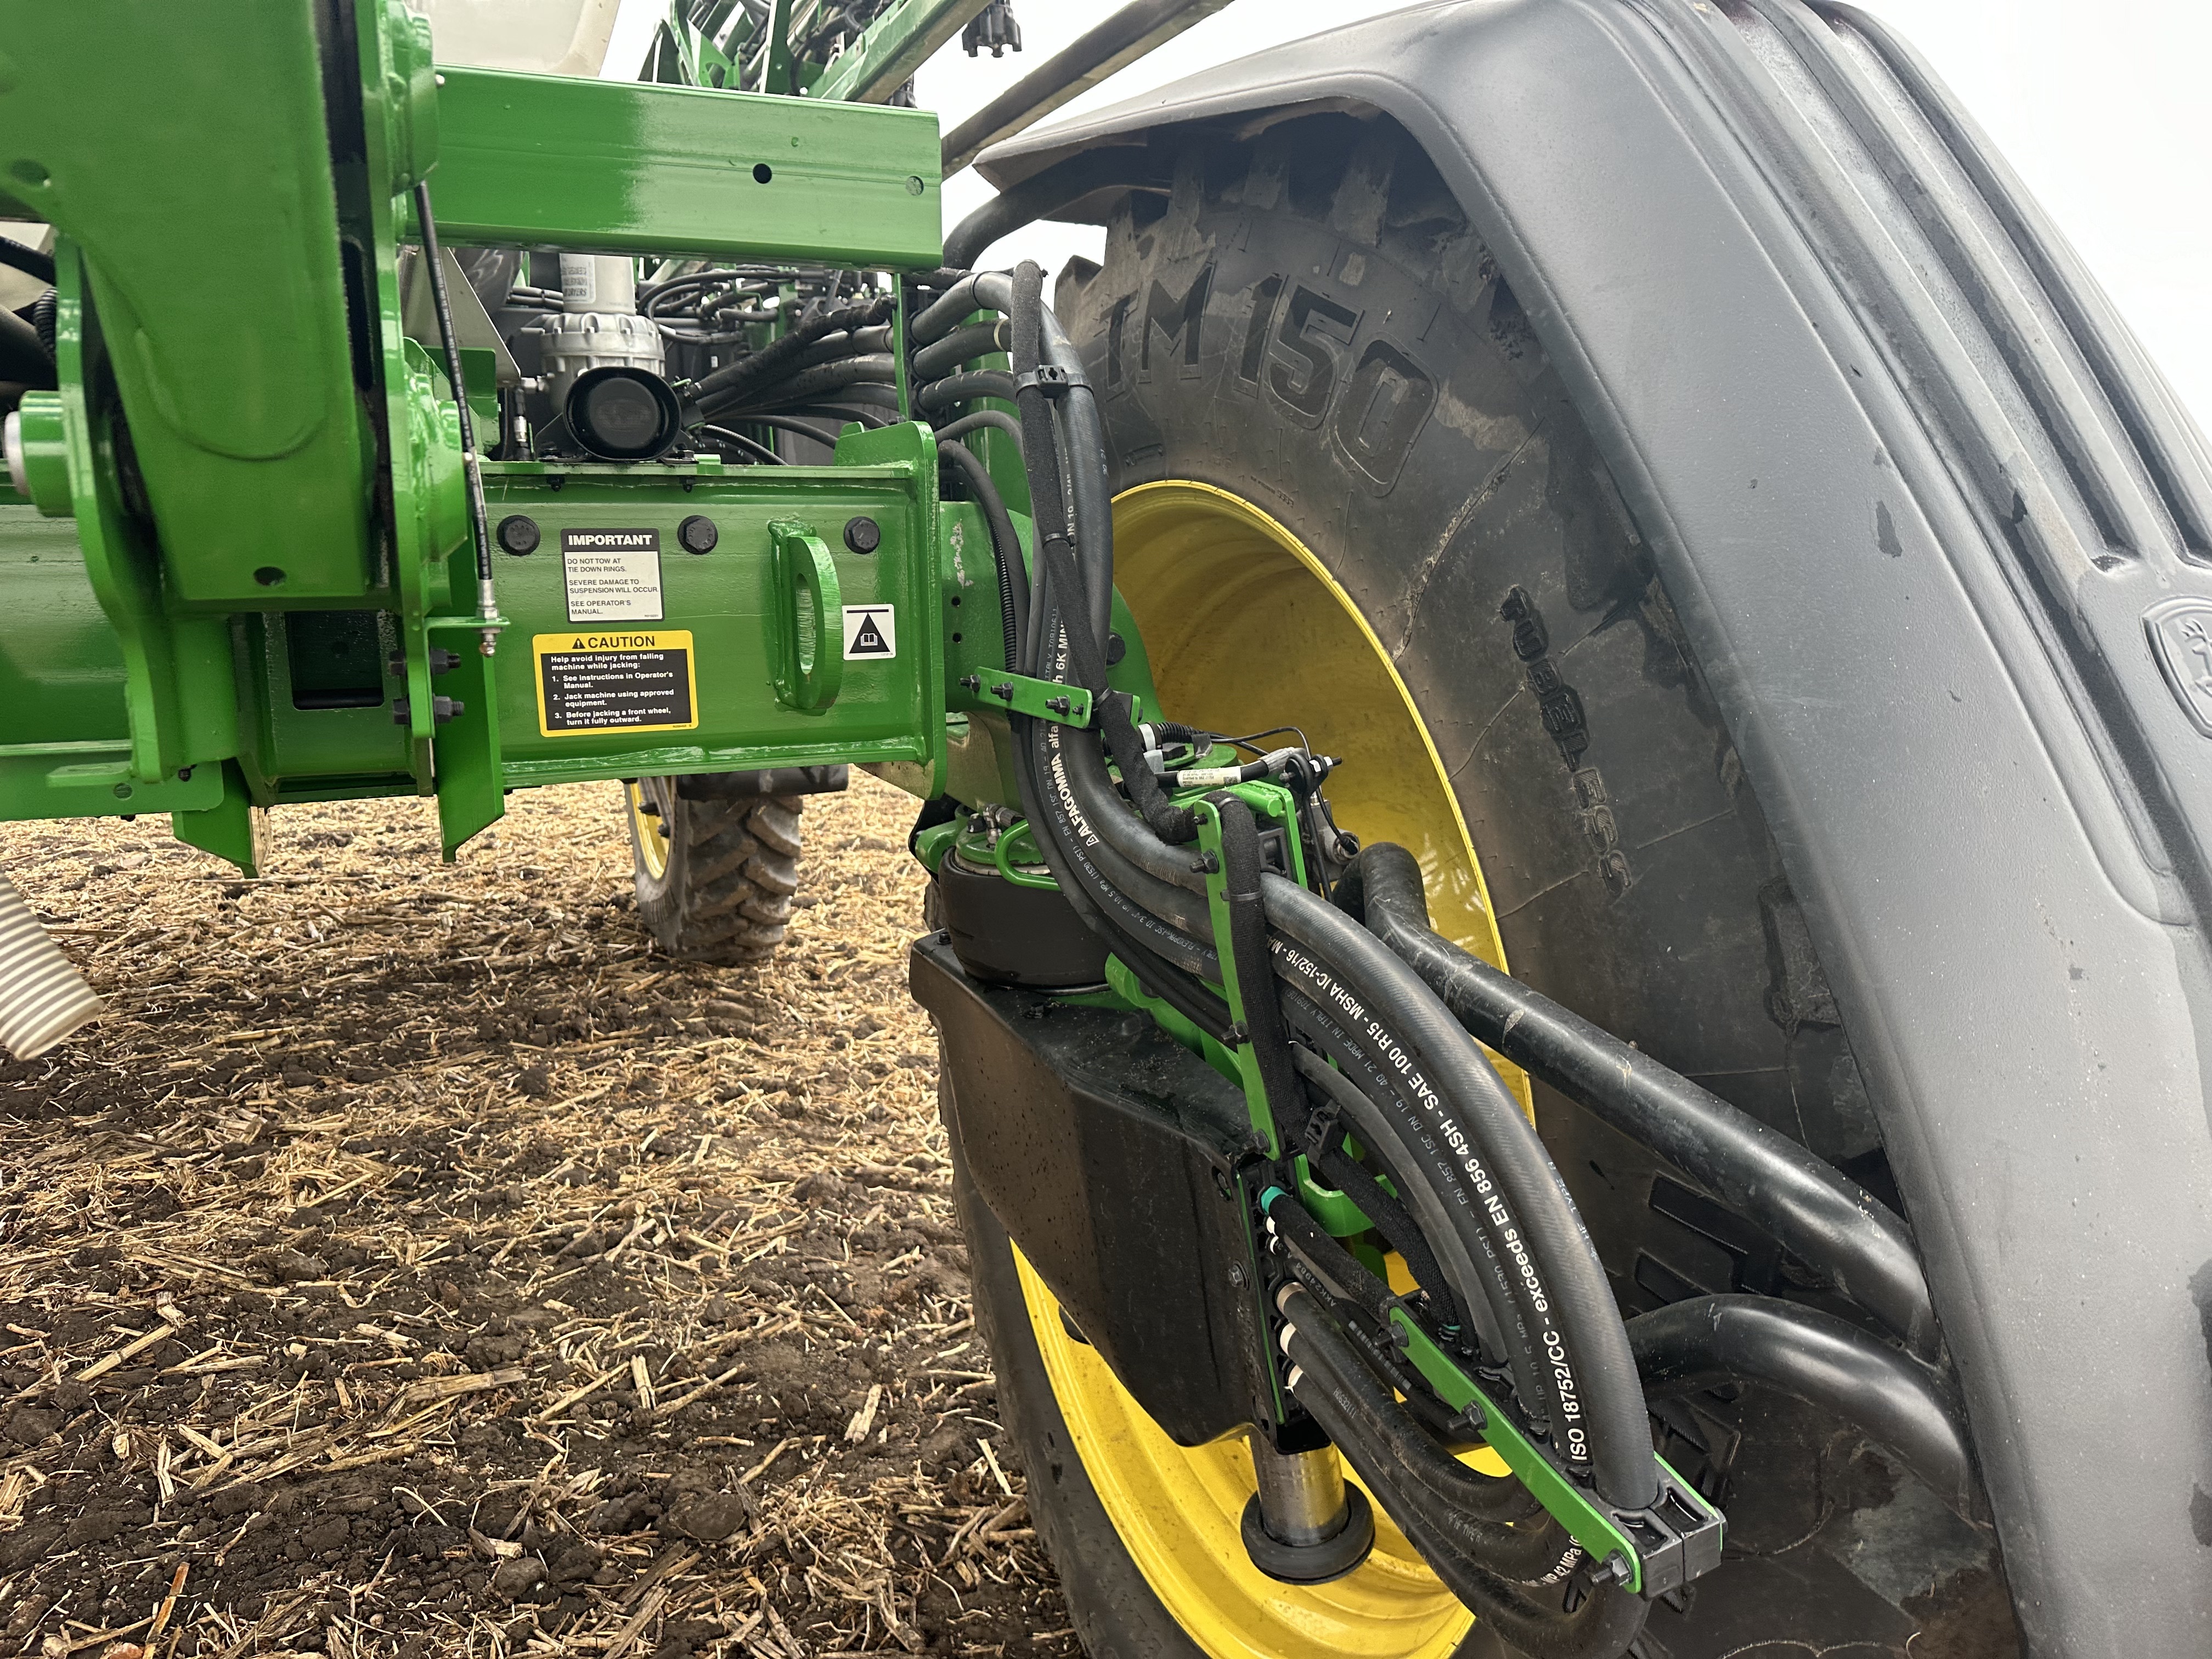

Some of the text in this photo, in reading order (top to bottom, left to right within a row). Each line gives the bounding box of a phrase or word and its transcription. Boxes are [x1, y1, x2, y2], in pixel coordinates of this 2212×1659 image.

[1095, 261, 1437, 495] TM 150
[568, 535, 652, 545] IMPORTANT
[588, 636, 655, 648] CAUTION
[551, 656, 569, 664] Help
[595, 654, 617, 662] injury
[1056, 652, 1066, 670] 6K
[640, 689, 674, 697] approved
[1501, 585, 1632, 896] TUBELESS
[1051, 752, 1093, 837] ALFAGOMMA
[1055, 809, 1066, 823] 857
[1061, 824, 1072, 836] EN
[1072, 843, 1087, 862] PSI)
[1286, 950, 1332, 990] IC-152/16
[1330, 982, 1365, 1020] MSHA
[1310, 1006, 1334, 1030] ITALY
[1331, 1025, 1345, 1039] IN
[1366, 1022, 1393, 1051] R15
[1342, 1037, 1365, 1060] MADE
[1389, 1047, 1412, 1075] 100
[1363, 1059, 1377, 1073] 21
[1408, 1073, 1439, 1110] SAE
[1395, 1097, 1409, 1113] 19
[1407, 1114, 1423, 1132] DN
[1419, 1132, 1441, 1155] 1SC
[1440, 1119, 1469, 1155] 4SH
[1437, 1158, 1457, 1184] 857
[1464, 1158, 1492, 1194] 856
[1484, 1194, 1510, 1226] EN
[1504, 1228, 1548, 1312] exceeds
[1543, 1330, 1581, 1422] 18752/CC
[1567, 1428, 1587, 1460] ISO
[1553, 1561, 1571, 1577] 42
[1557, 1542, 1585, 1571] MPa
